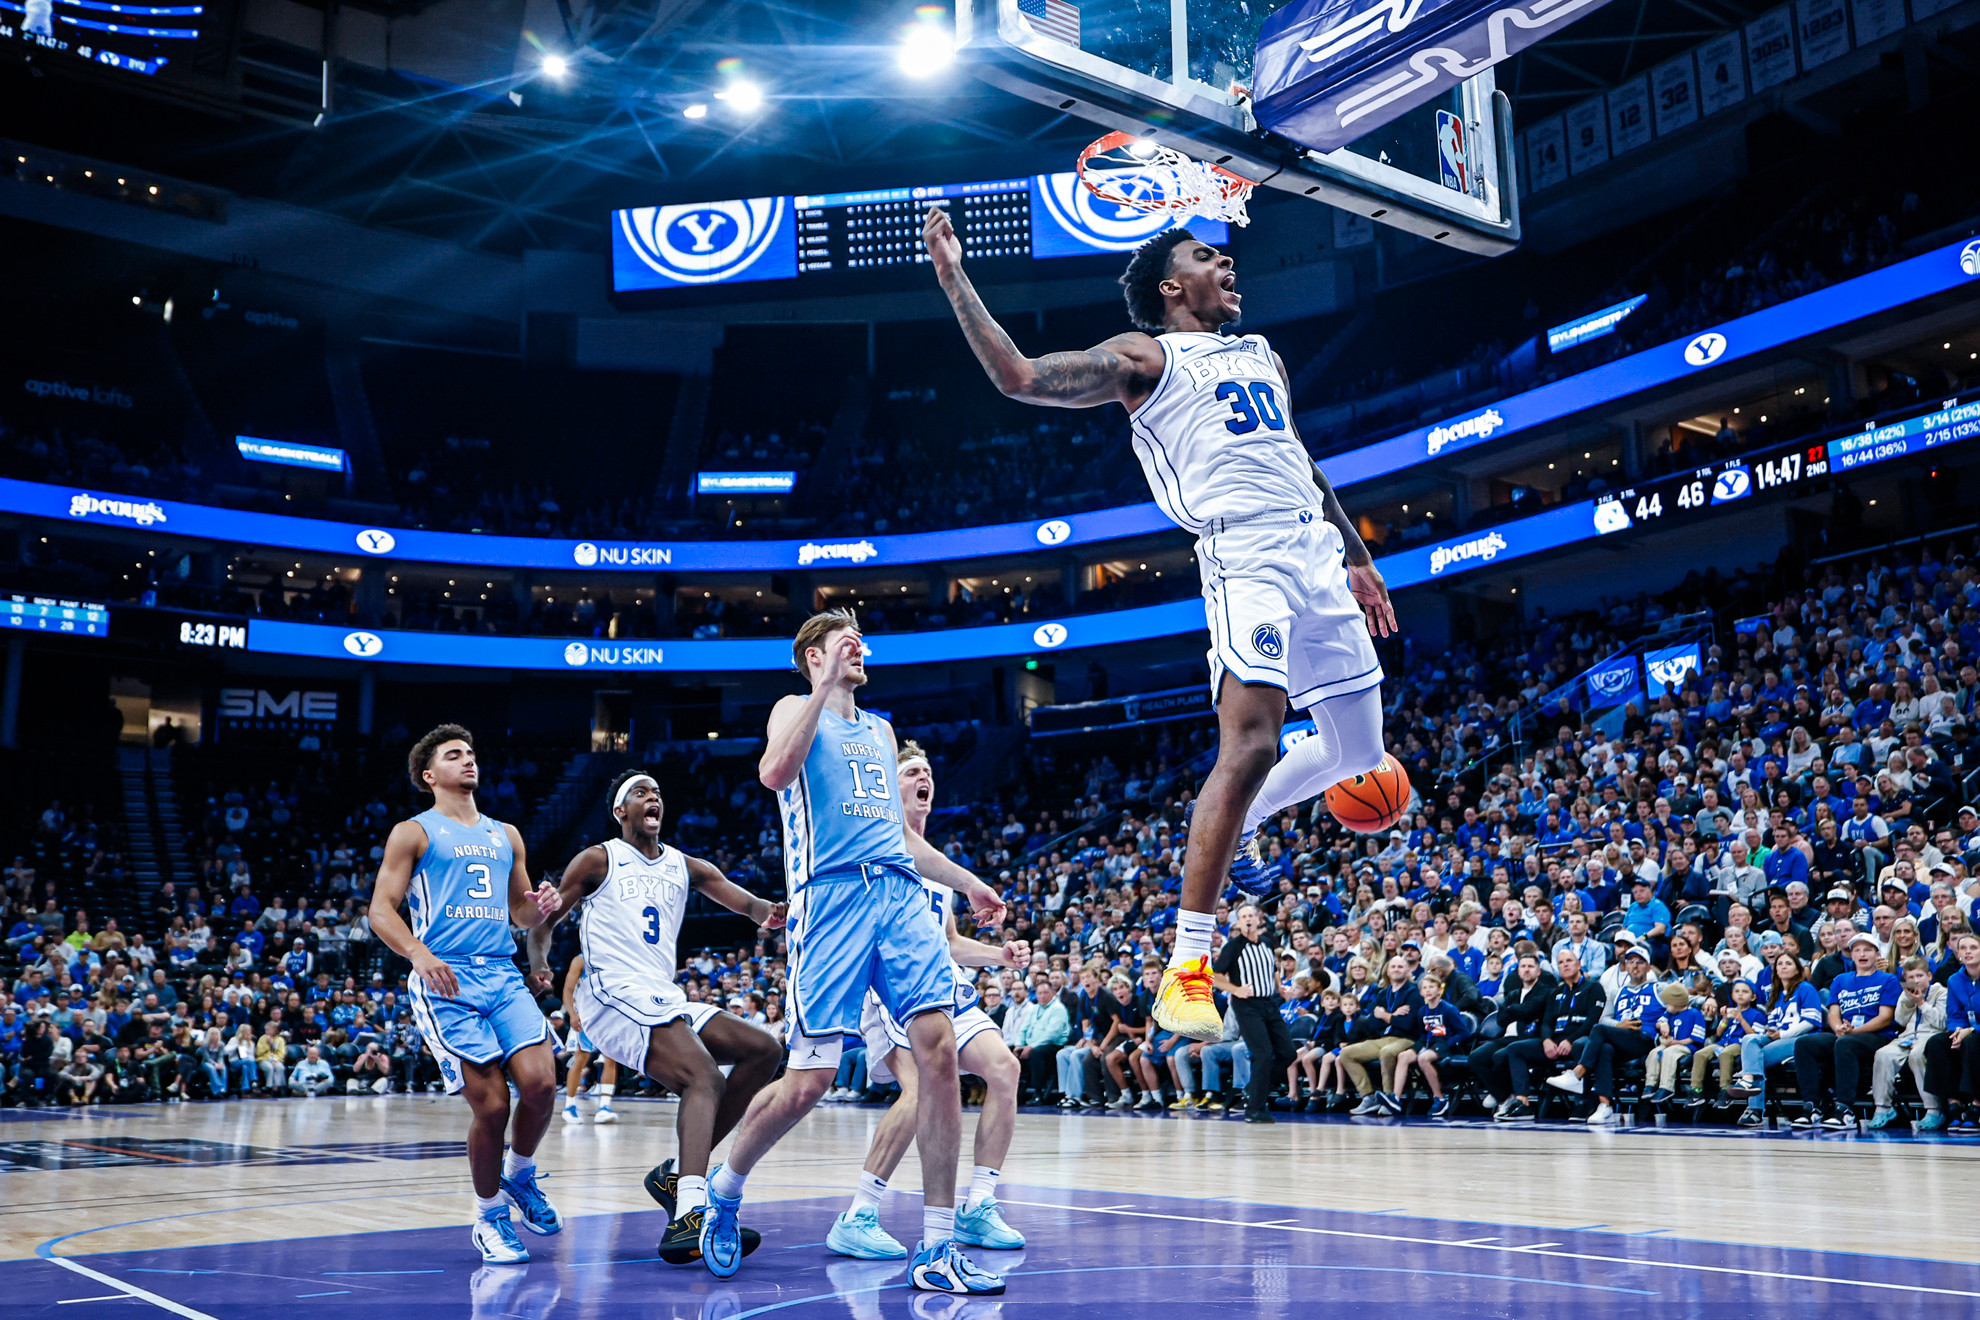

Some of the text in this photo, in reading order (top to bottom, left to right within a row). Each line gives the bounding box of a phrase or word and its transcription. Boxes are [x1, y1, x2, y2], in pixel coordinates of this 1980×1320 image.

[1802, 9, 1844, 40] 1223
[1751, 34, 1791, 63] 3051
[1715, 63, 1729, 83] 4
[1661, 82, 1688, 109] 32
[1618, 104, 1640, 130] 12
[1580, 127, 1594, 147] 9
[1537, 144, 1556, 166] 14
[1445, 173, 1458, 190] NBA
[245, 310, 298, 329] aptive
[1691, 339, 1717, 360] Y
[25, 379, 133, 409] aptive lofts
[1942, 397, 1958, 410] 3PT
[1214, 381, 1286, 436] 30
[1865, 421, 1876, 432] FG
[1923, 411, 1950, 430] 3/14
[1840, 424, 1906, 452] 16/38 (42%)
[1925, 428, 1951, 445] 2/15
[1807, 445, 1824, 463] 27
[1841, 440, 1907, 468] 16/44 (36%)
[1754, 453, 1801, 490] 14:47
[1806, 461, 1828, 478] 2ND
[1677, 481, 1705, 510] 46
[1635, 492, 1662, 521] 44
[366, 533, 386, 549] Y
[1046, 525, 1062, 540] Y
[600, 548, 671, 565] NU SKIN
[41, 606, 48, 616] 7
[10, 616, 22, 626] 10
[87, 624, 95, 633] 6
[180, 622, 245, 649] 8:23 PM
[355, 636, 373, 652] Y
[1042, 628, 1059, 642] Y
[591, 648, 664, 664] NU SKIN
[220, 688, 338, 720] SME
[1142, 699, 1175, 711] HEALTH
[841, 742, 883, 761] NORTH
[849, 760, 891, 801] 13
[841, 801, 901, 825] CAROLINA
[453, 844, 497, 861] NORTH
[466, 862, 493, 900] 3
[619, 874, 681, 909] BYU
[445, 904, 505, 922] CAROLINA
[642, 905, 660, 945] 3
